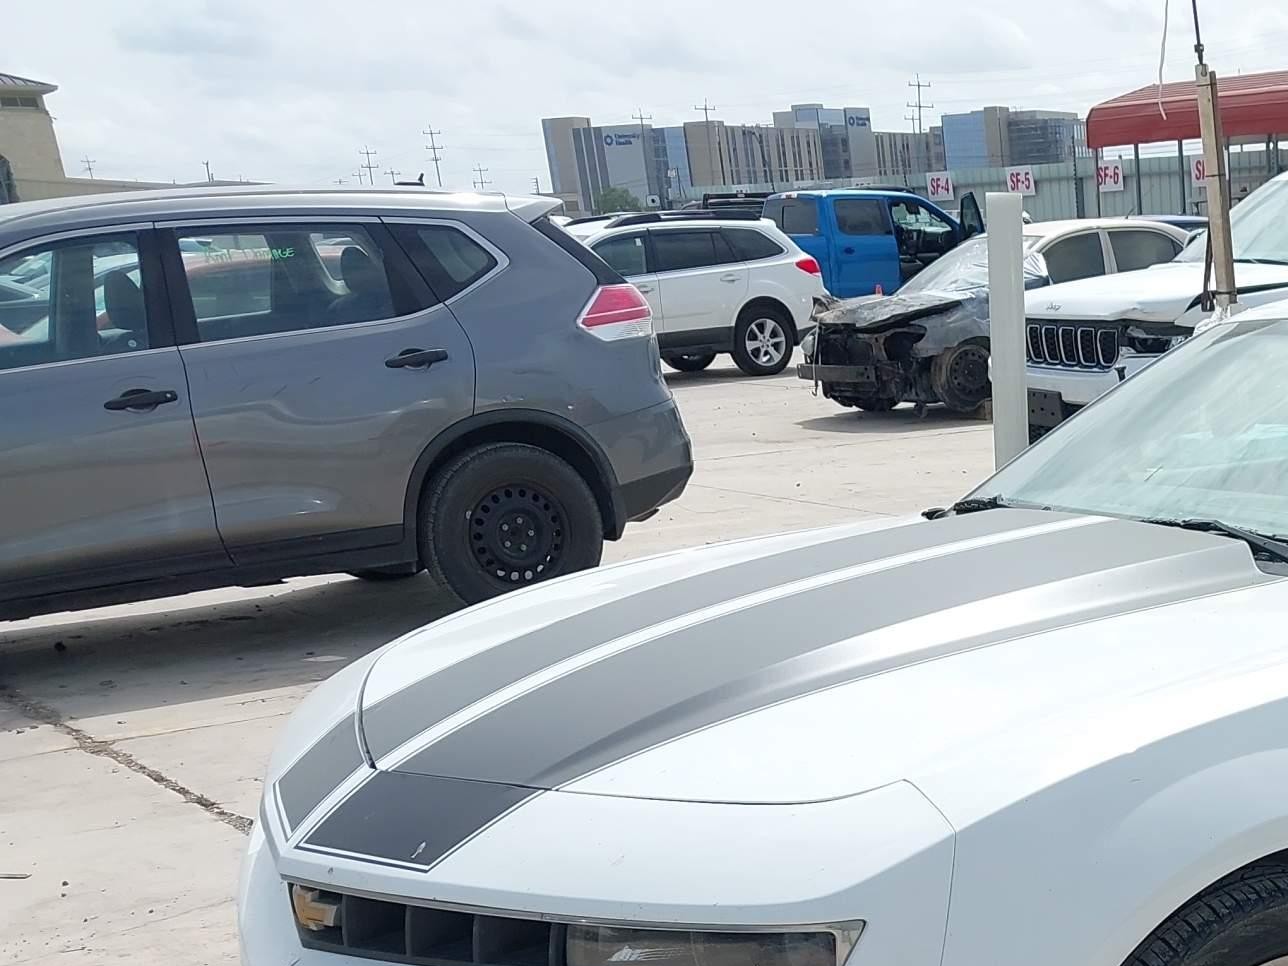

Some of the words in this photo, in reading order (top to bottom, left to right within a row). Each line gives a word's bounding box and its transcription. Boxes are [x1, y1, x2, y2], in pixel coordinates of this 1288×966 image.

[1009, 171, 1031, 192] SF-5
[1096, 165, 1119, 187] SF-6
[930, 177, 950, 197] SF-4
